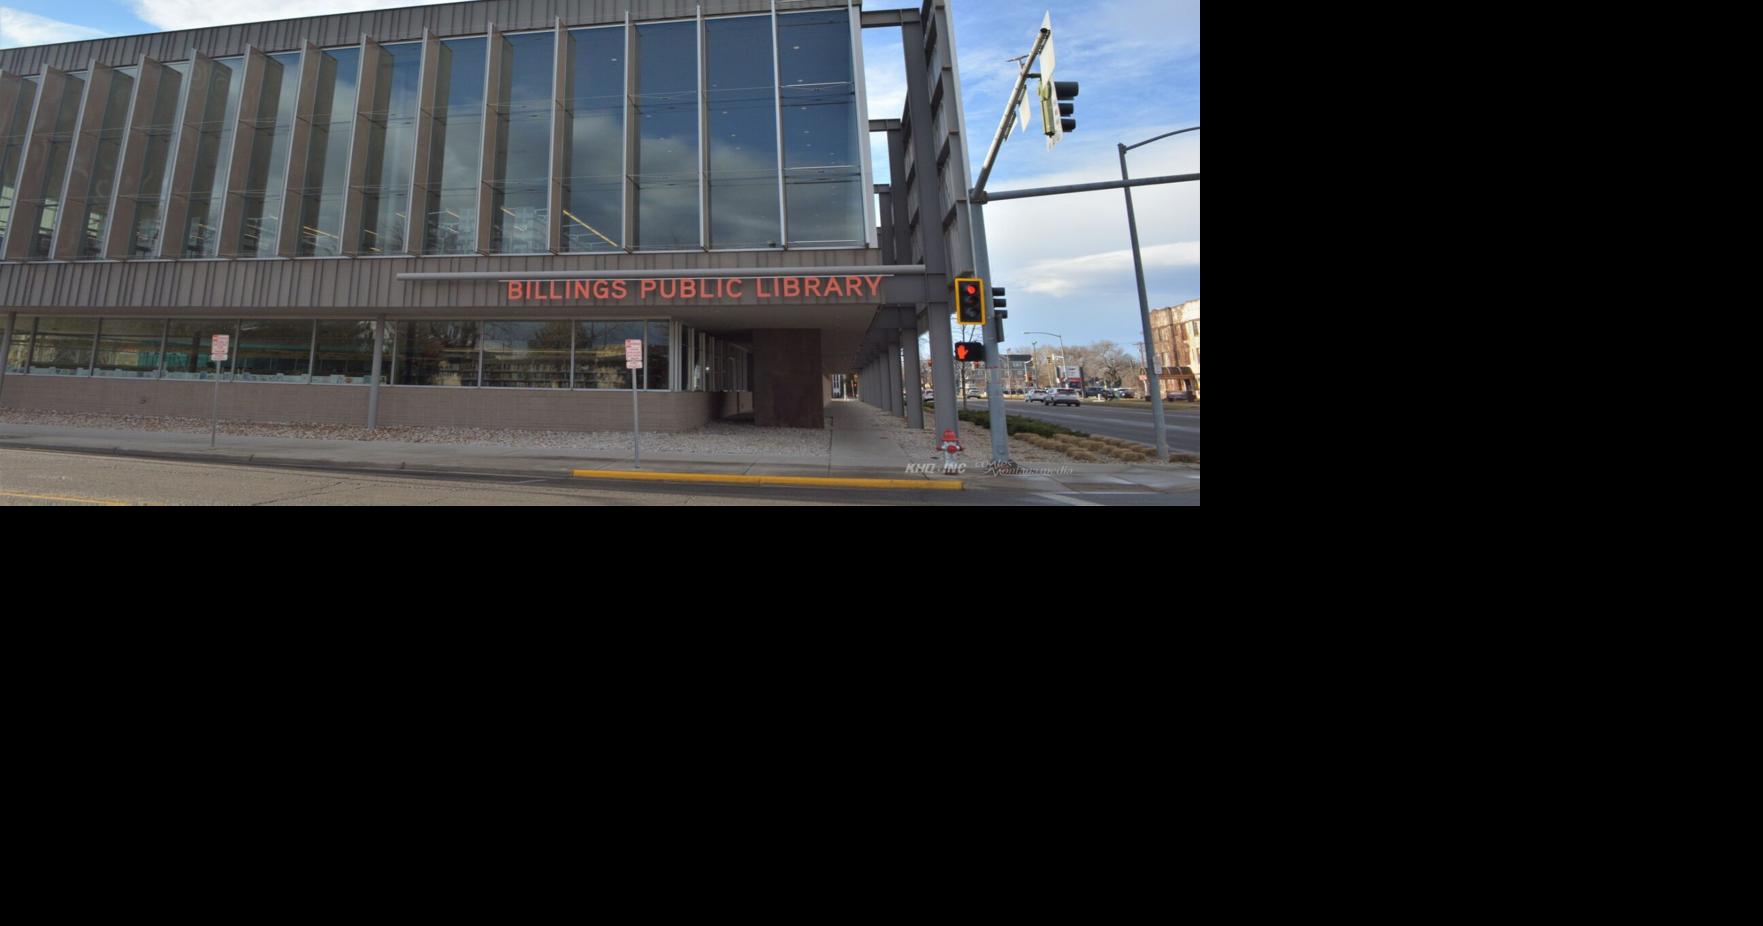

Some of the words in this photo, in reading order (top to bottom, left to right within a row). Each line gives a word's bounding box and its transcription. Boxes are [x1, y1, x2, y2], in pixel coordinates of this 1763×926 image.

[507, 280, 628, 300] BILLINGS
[640, 278, 743, 299] PUBLIC
[756, 275, 882, 298] LIBRARY
